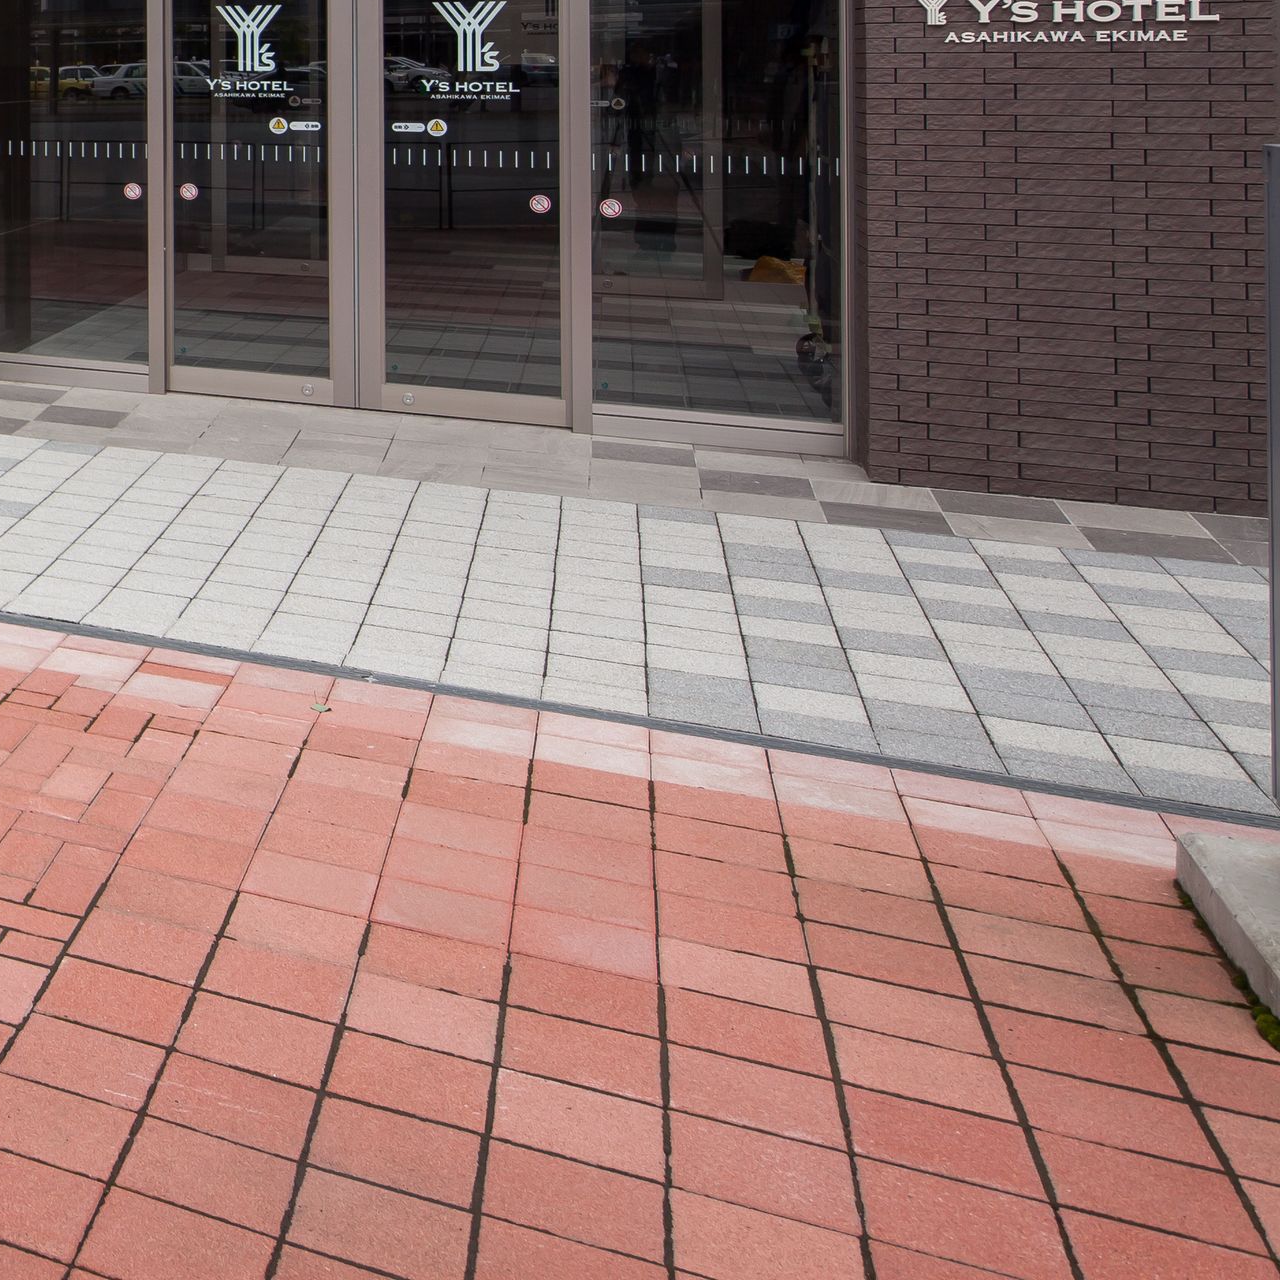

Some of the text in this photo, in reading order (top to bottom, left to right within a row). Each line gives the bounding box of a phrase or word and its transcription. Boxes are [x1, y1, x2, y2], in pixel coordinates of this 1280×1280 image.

[944, 29, 1188, 43] ASAHIKAWA EKIMAE
[236, 81, 294, 91] HOTEL
[455, 81, 521, 93] HOTEL
